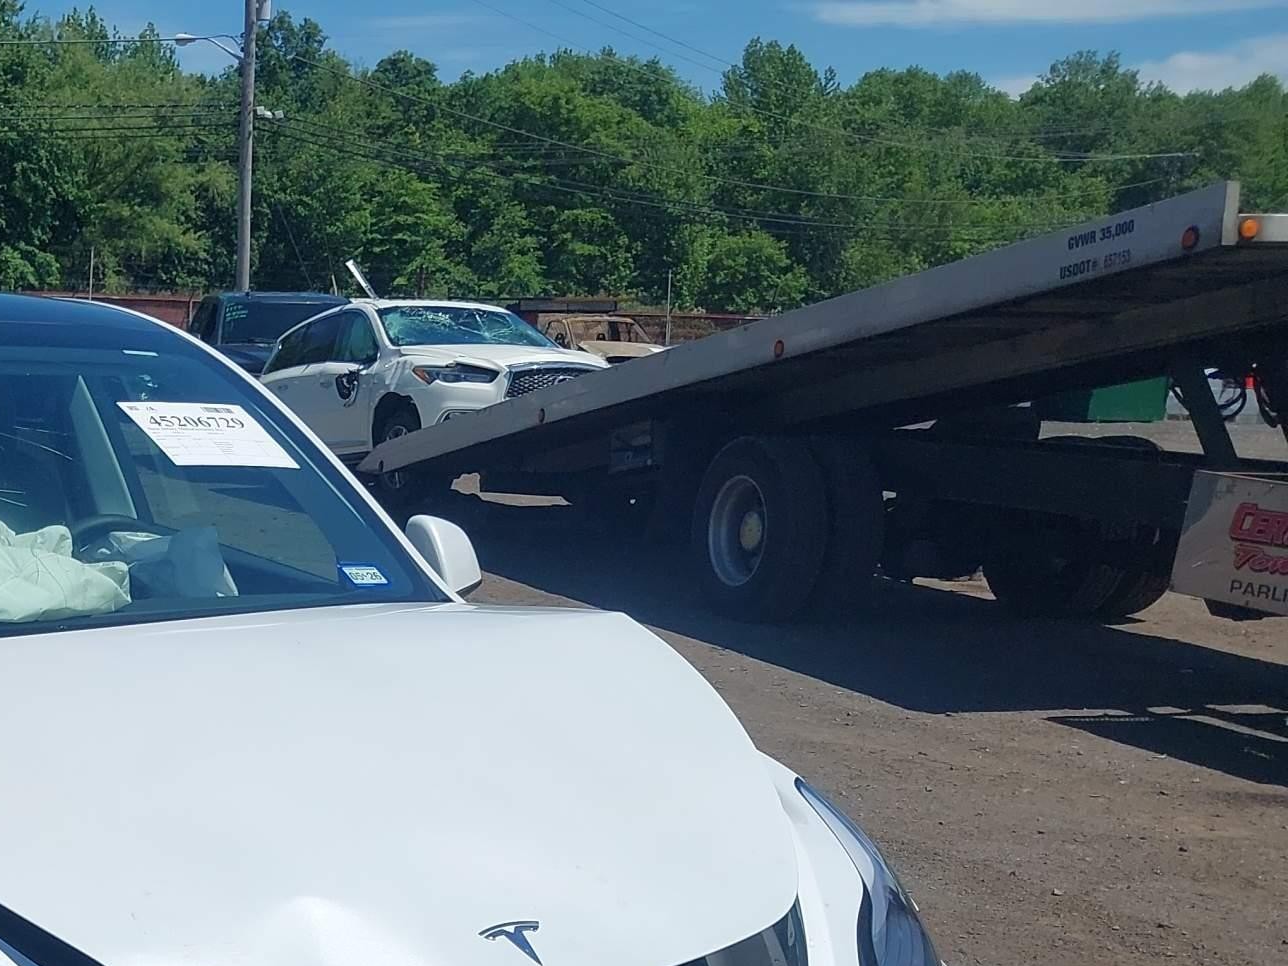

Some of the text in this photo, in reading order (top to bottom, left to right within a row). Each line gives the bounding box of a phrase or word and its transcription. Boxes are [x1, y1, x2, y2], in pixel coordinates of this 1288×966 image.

[1067, 219, 1135, 250] GVWR 35,000
[149, 415, 245, 429] 45206729
